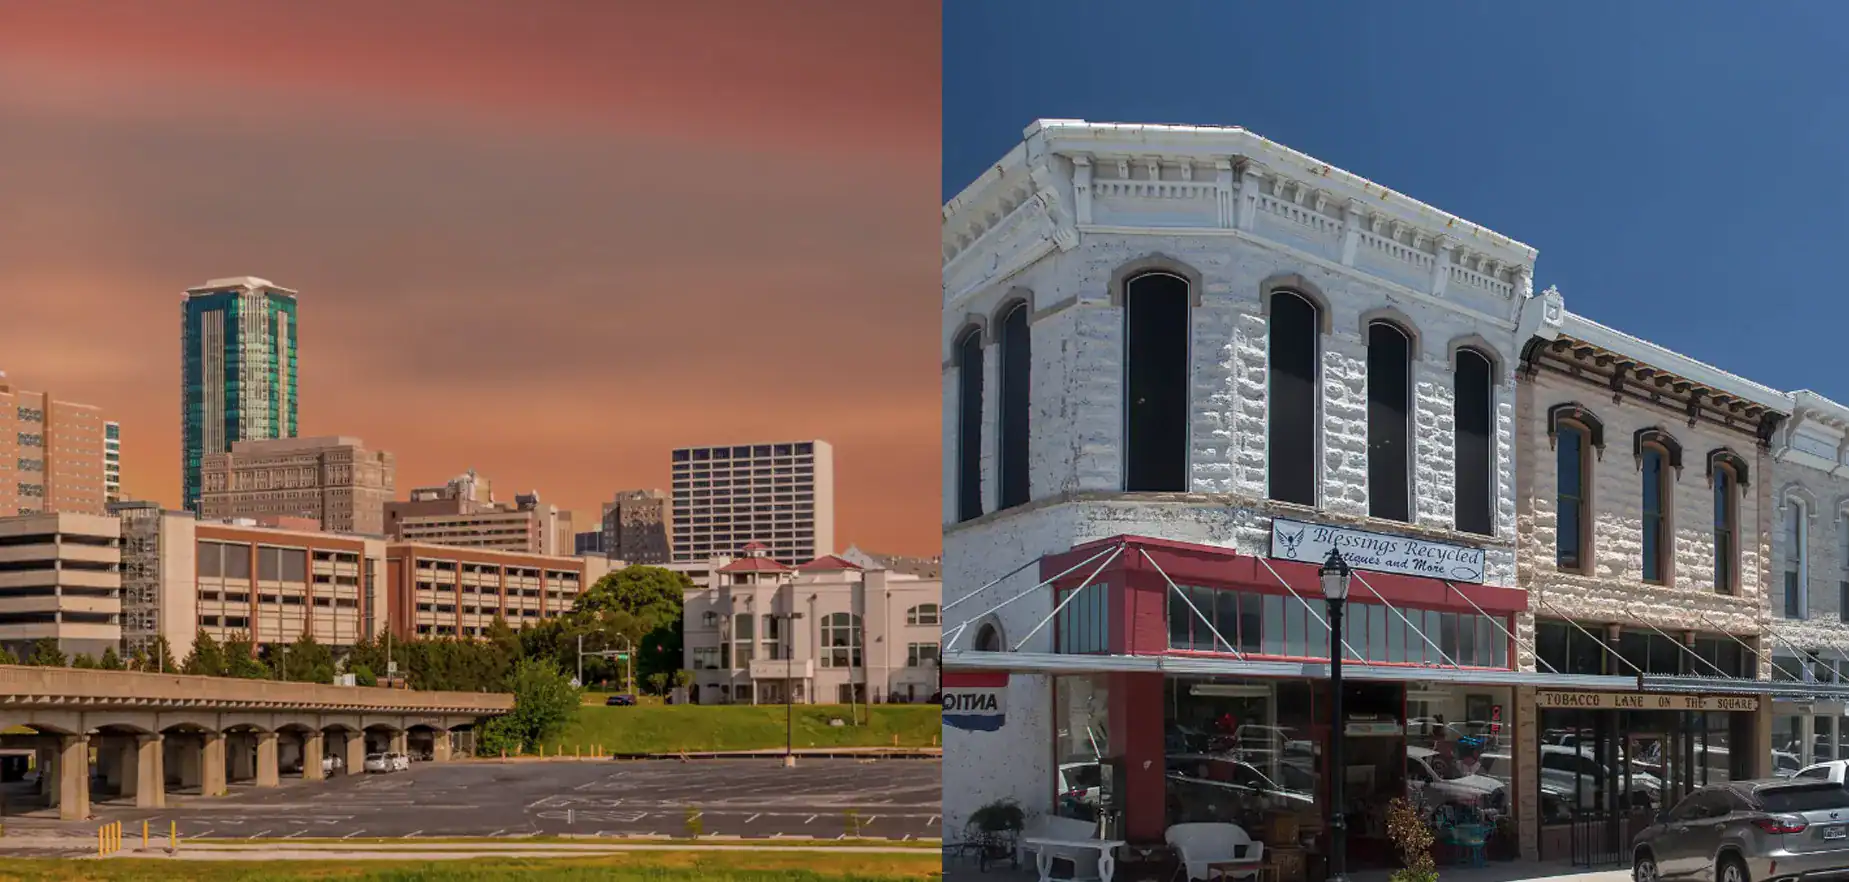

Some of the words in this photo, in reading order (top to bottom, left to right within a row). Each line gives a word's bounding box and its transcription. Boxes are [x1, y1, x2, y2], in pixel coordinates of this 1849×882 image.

[1313, 528, 1398, 556] Blessings
[1404, 541, 1479, 565] Recycled
[1323, 548, 1381, 566] tiques
[1386, 559, 1408, 569] and
[1412, 558, 1445, 573] More
[1546, 693, 1600, 706] TOBACCO
[1615, 695, 1644, 707] LANE
[1658, 696, 1671, 707] ON
[1685, 697, 1703, 709] THE
[1717, 698, 1753, 710] SQUARE
